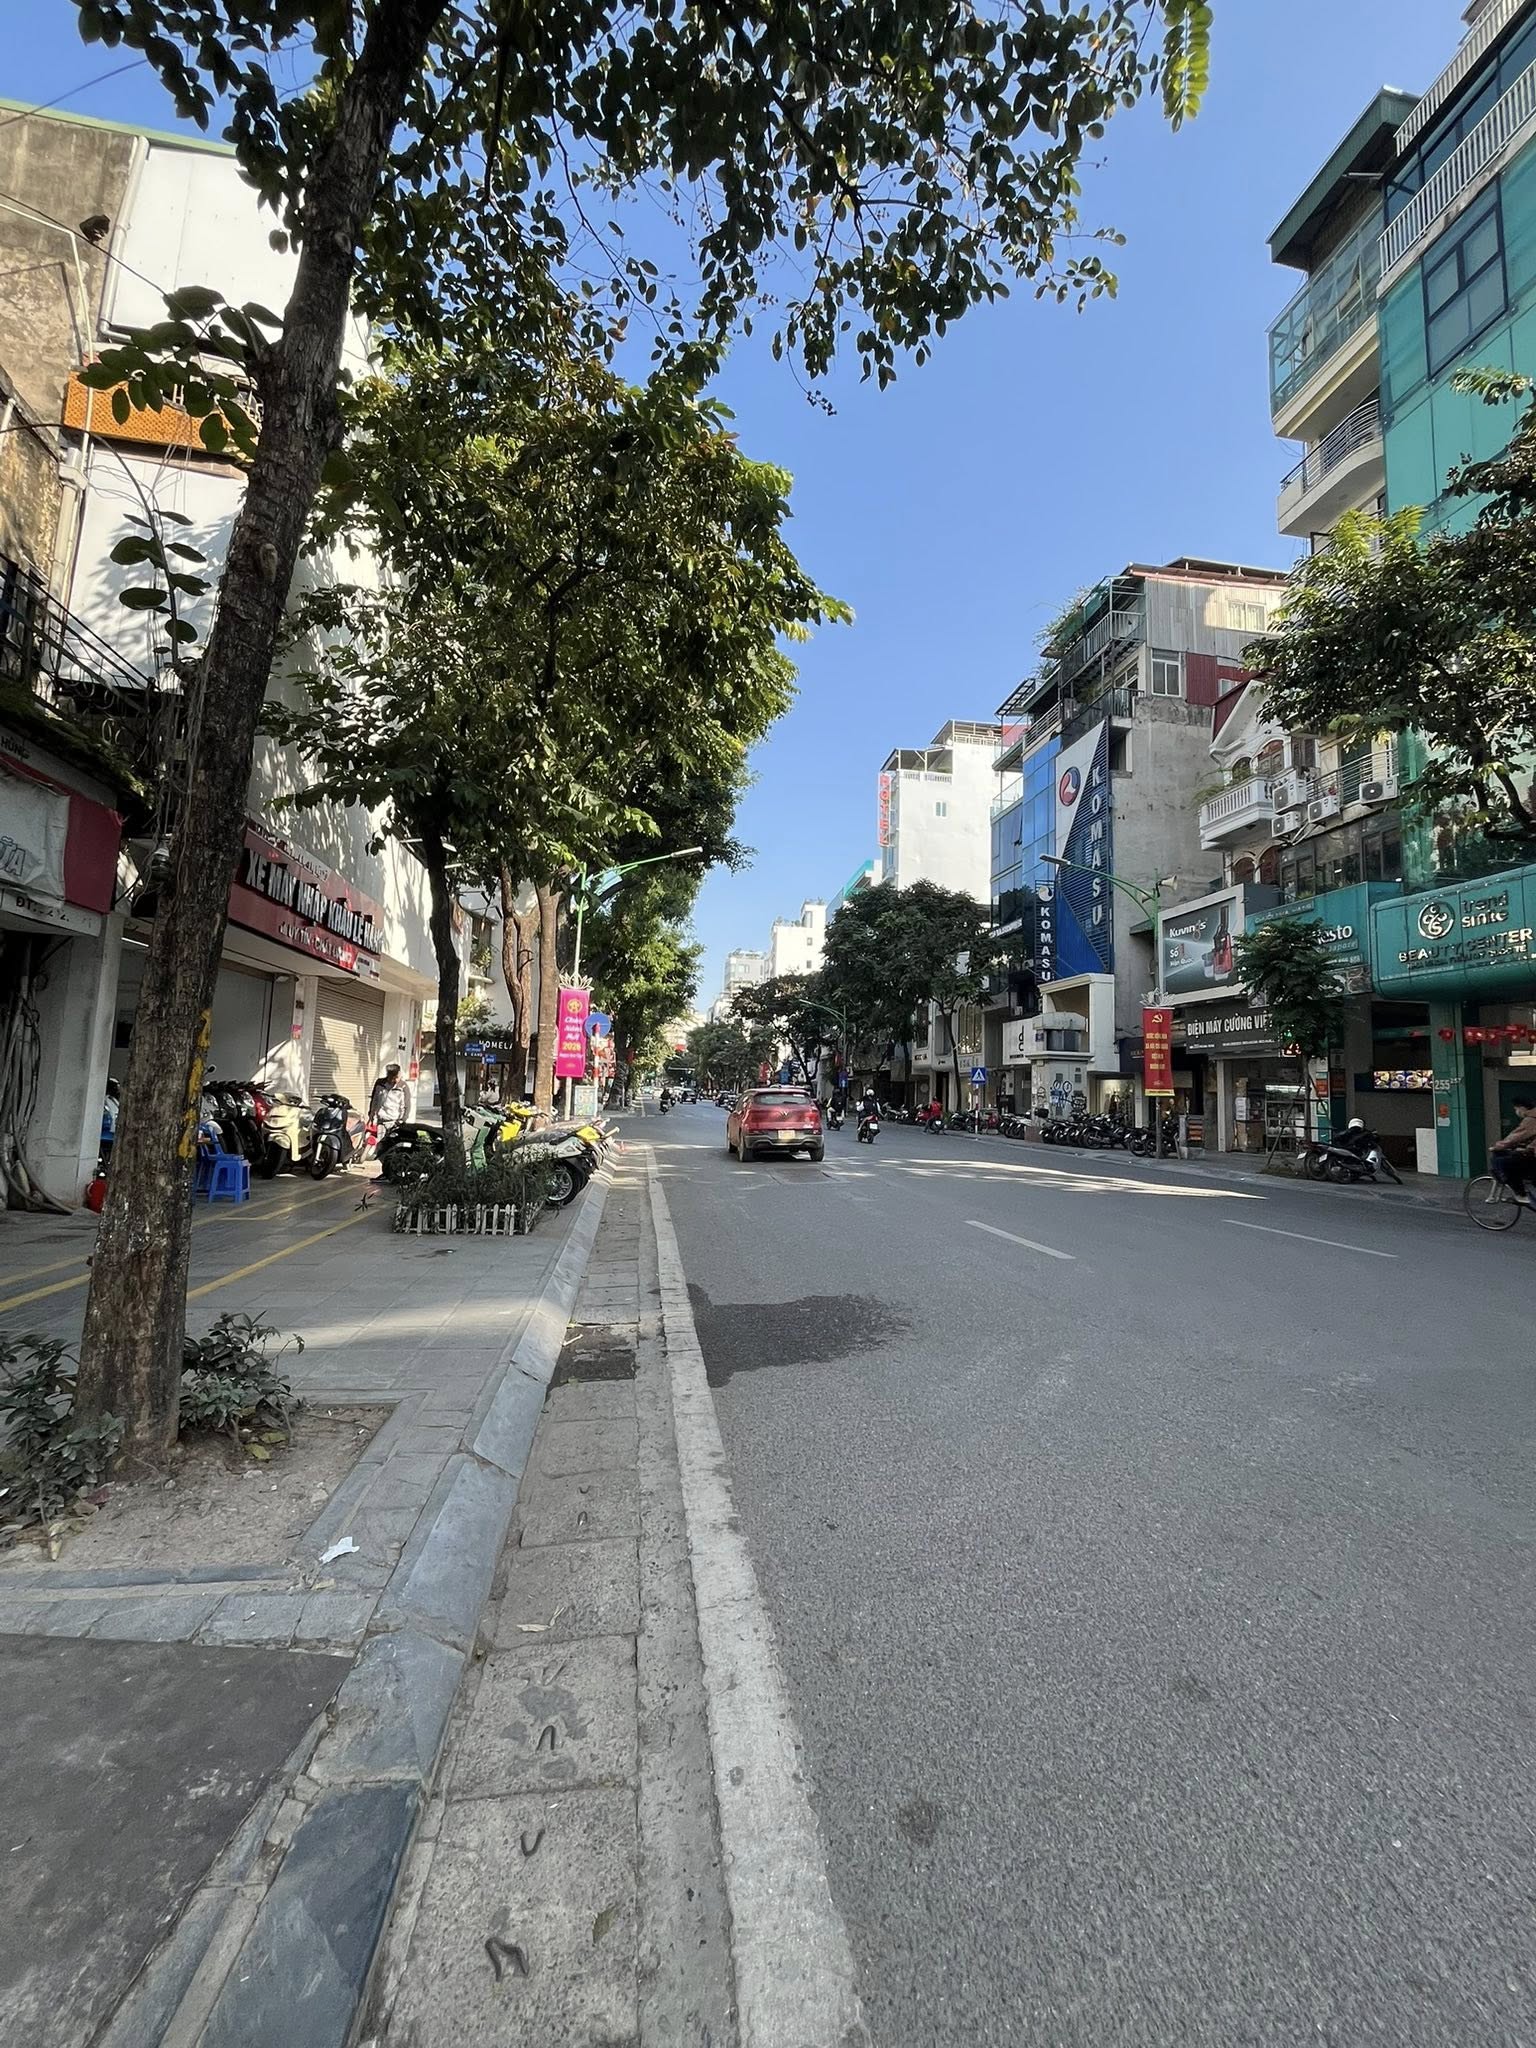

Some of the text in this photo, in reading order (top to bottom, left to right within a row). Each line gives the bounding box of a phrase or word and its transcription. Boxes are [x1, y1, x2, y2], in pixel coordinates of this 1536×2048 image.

[1091, 766, 1103, 926] KOMASU
[245, 850, 268, 892] XE
[267, 862, 298, 909] MÁY
[297, 879, 328, 927] NHẬP
[327, 900, 354, 940] KHẨU
[352, 914, 365, 945] LÊ
[1461, 889, 1509, 913] trend
[288, 924, 300, 941] UY
[1040, 906, 1052, 982] KOMASU
[1169, 919, 1206, 942] Kuvings
[1398, 943, 1463, 962] BEAUTY
[1466, 928, 1533, 953] CENTER
[1187, 1019, 1205, 1039] ĐIỆN
[1205, 1016, 1222, 1034] MÁY
[1223, 1012, 1253, 1032] CƯỜNG
[1434, 1079, 1450, 1090] 255
